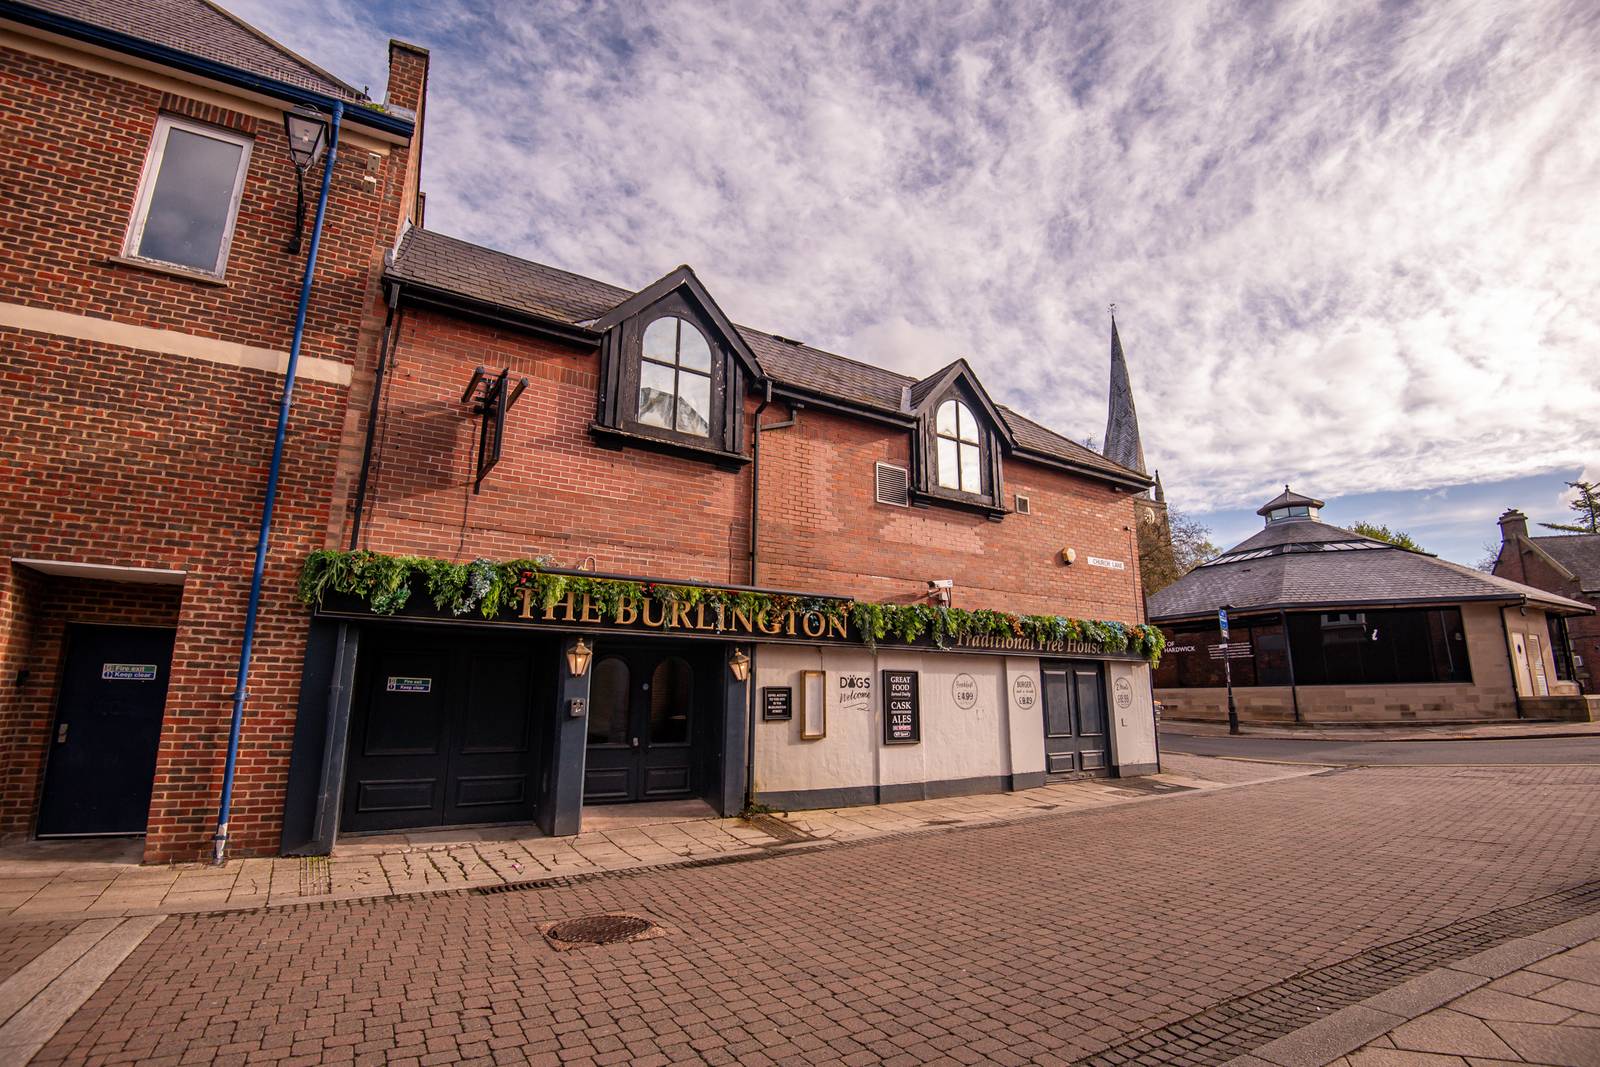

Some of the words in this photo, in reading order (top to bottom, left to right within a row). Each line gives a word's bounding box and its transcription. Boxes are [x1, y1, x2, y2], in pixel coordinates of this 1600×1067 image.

[1093, 559, 1110, 567] CHURCH
[514, 587, 602, 623] THE
[614, 594, 849, 639] BURLINGTON
[956, 630, 1035, 651] Traditional
[1067, 637, 1103, 655] House
[1164, 646, 1196, 654] HARDWICK
[114, 671, 132, 679] Keep
[891, 701, 912, 710] CASK
[892, 714, 912, 724] ALES
